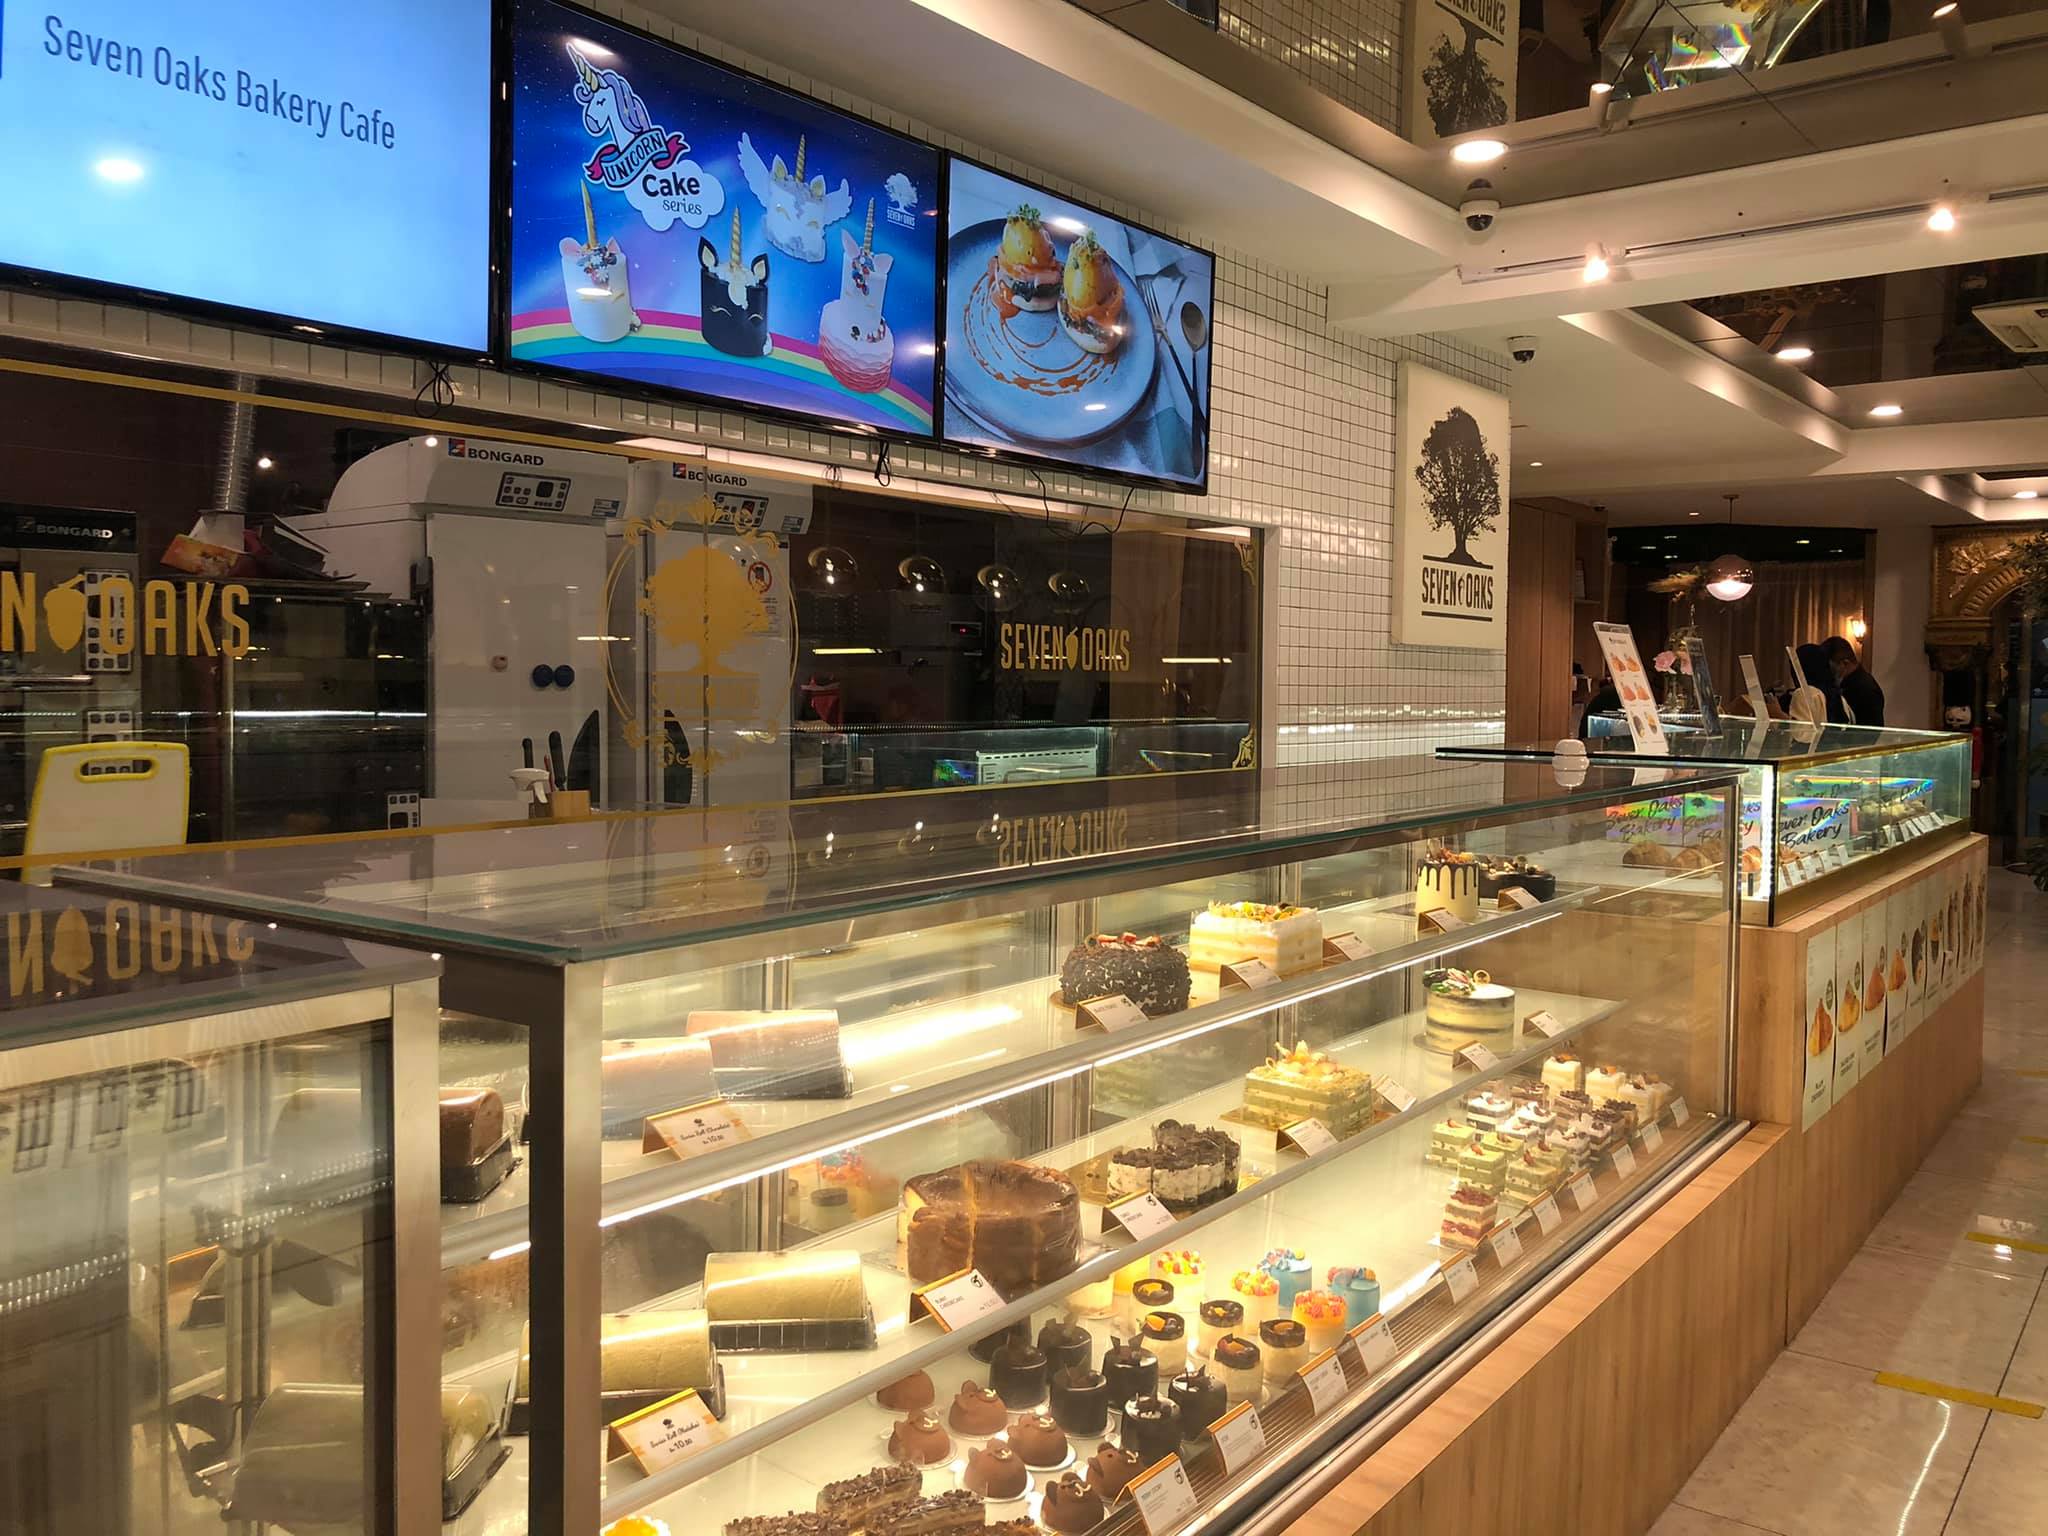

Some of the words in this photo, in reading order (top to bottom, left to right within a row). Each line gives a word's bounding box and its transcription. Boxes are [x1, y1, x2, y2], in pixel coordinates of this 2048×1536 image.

[44, 15, 143, 78] Seven
[154, 46, 227, 102] Oaks
[236, 70, 333, 138] Bakery
[340, 101, 396, 149] Cafe
[604, 132, 664, 182] UNICORN
[642, 171, 701, 197] Cake
[662, 198, 703, 215] series
[468, 447, 545, 466] BONGARD
[688, 470, 748, 487] BONGARD
[36, 523, 114, 539] BONGARD
[1422, 566, 1457, 606] SEVEN
[1466, 572, 1494, 610] OAKS
[100, 577, 250, 658] OAKS
[1000, 623, 1064, 670] SEVEN
[1081, 627, 1131, 672] OAKS
[1811, 802, 1850, 826] Oaks
[1780, 823, 1842, 849] Bakery
